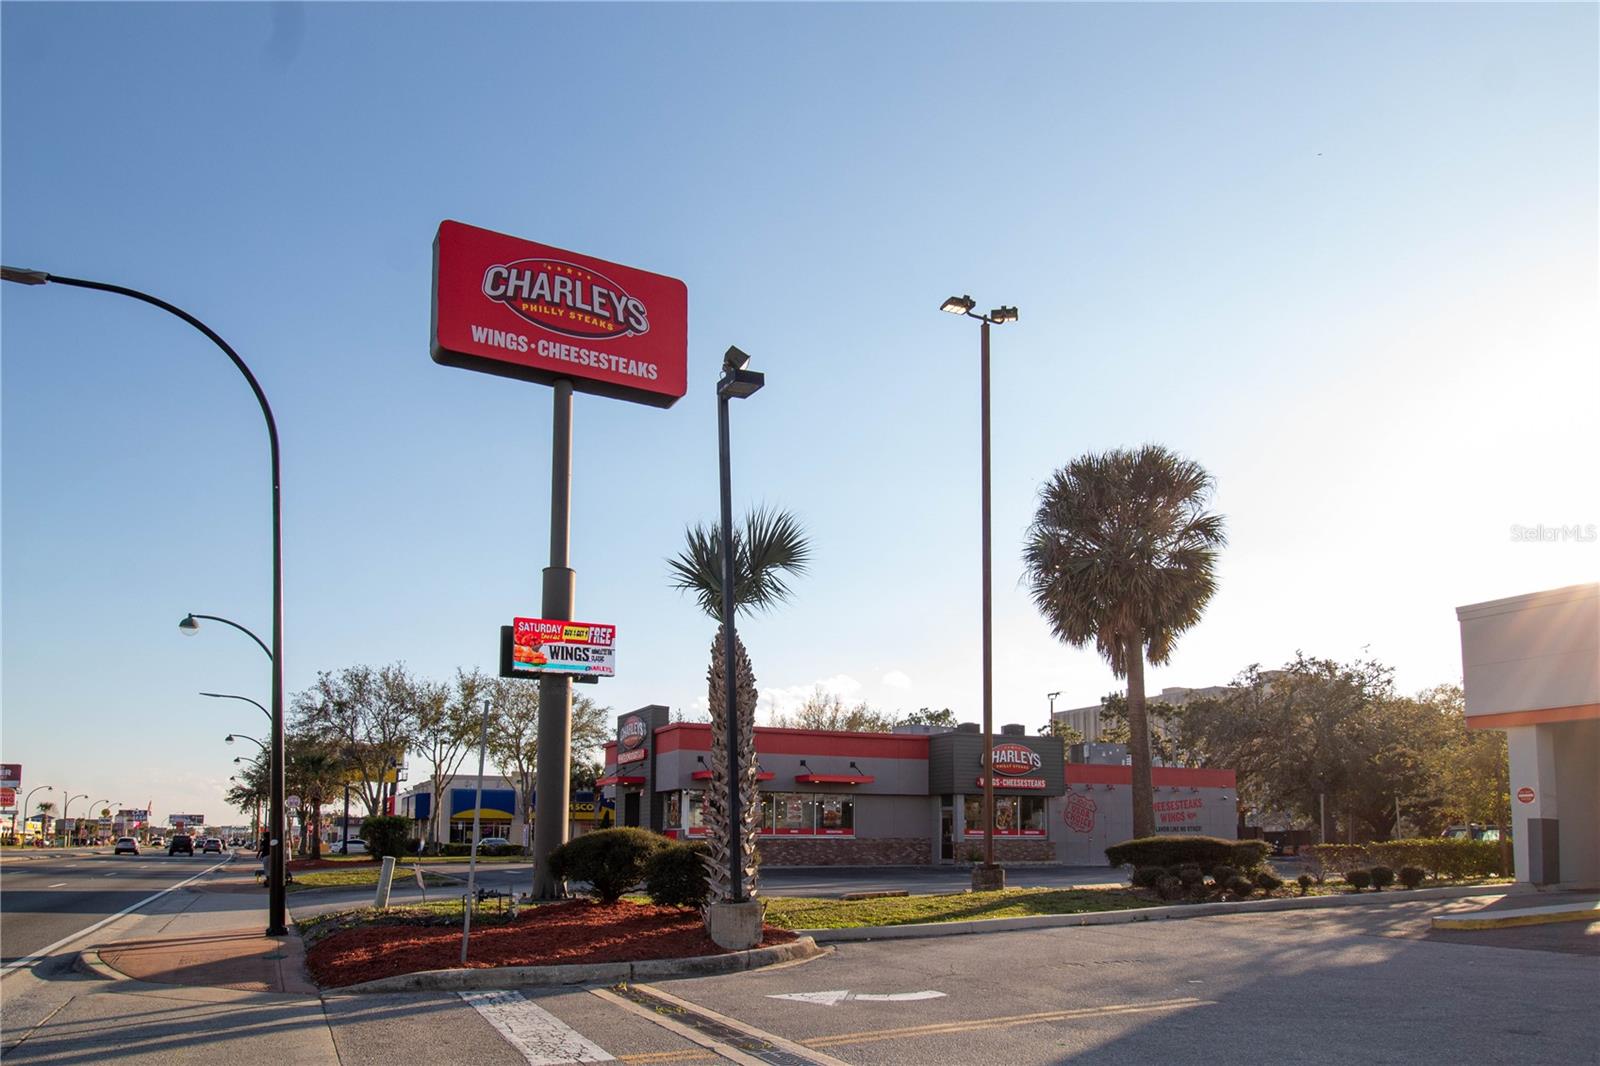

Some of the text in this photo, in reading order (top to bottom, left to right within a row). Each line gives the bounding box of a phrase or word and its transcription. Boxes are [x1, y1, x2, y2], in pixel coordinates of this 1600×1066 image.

[484, 267, 648, 331] CHARLEYS
[522, 303, 614, 331] PHILLY STEAKS
[471, 325, 658, 380] WINGS CHEESESTEAKS
[518, 621, 562, 633] SATURDAY
[588, 626, 612, 645] FREE
[549, 645, 590, 662] WINGS
[979, 778, 1046, 788] WGS CHEESESTEAKS
